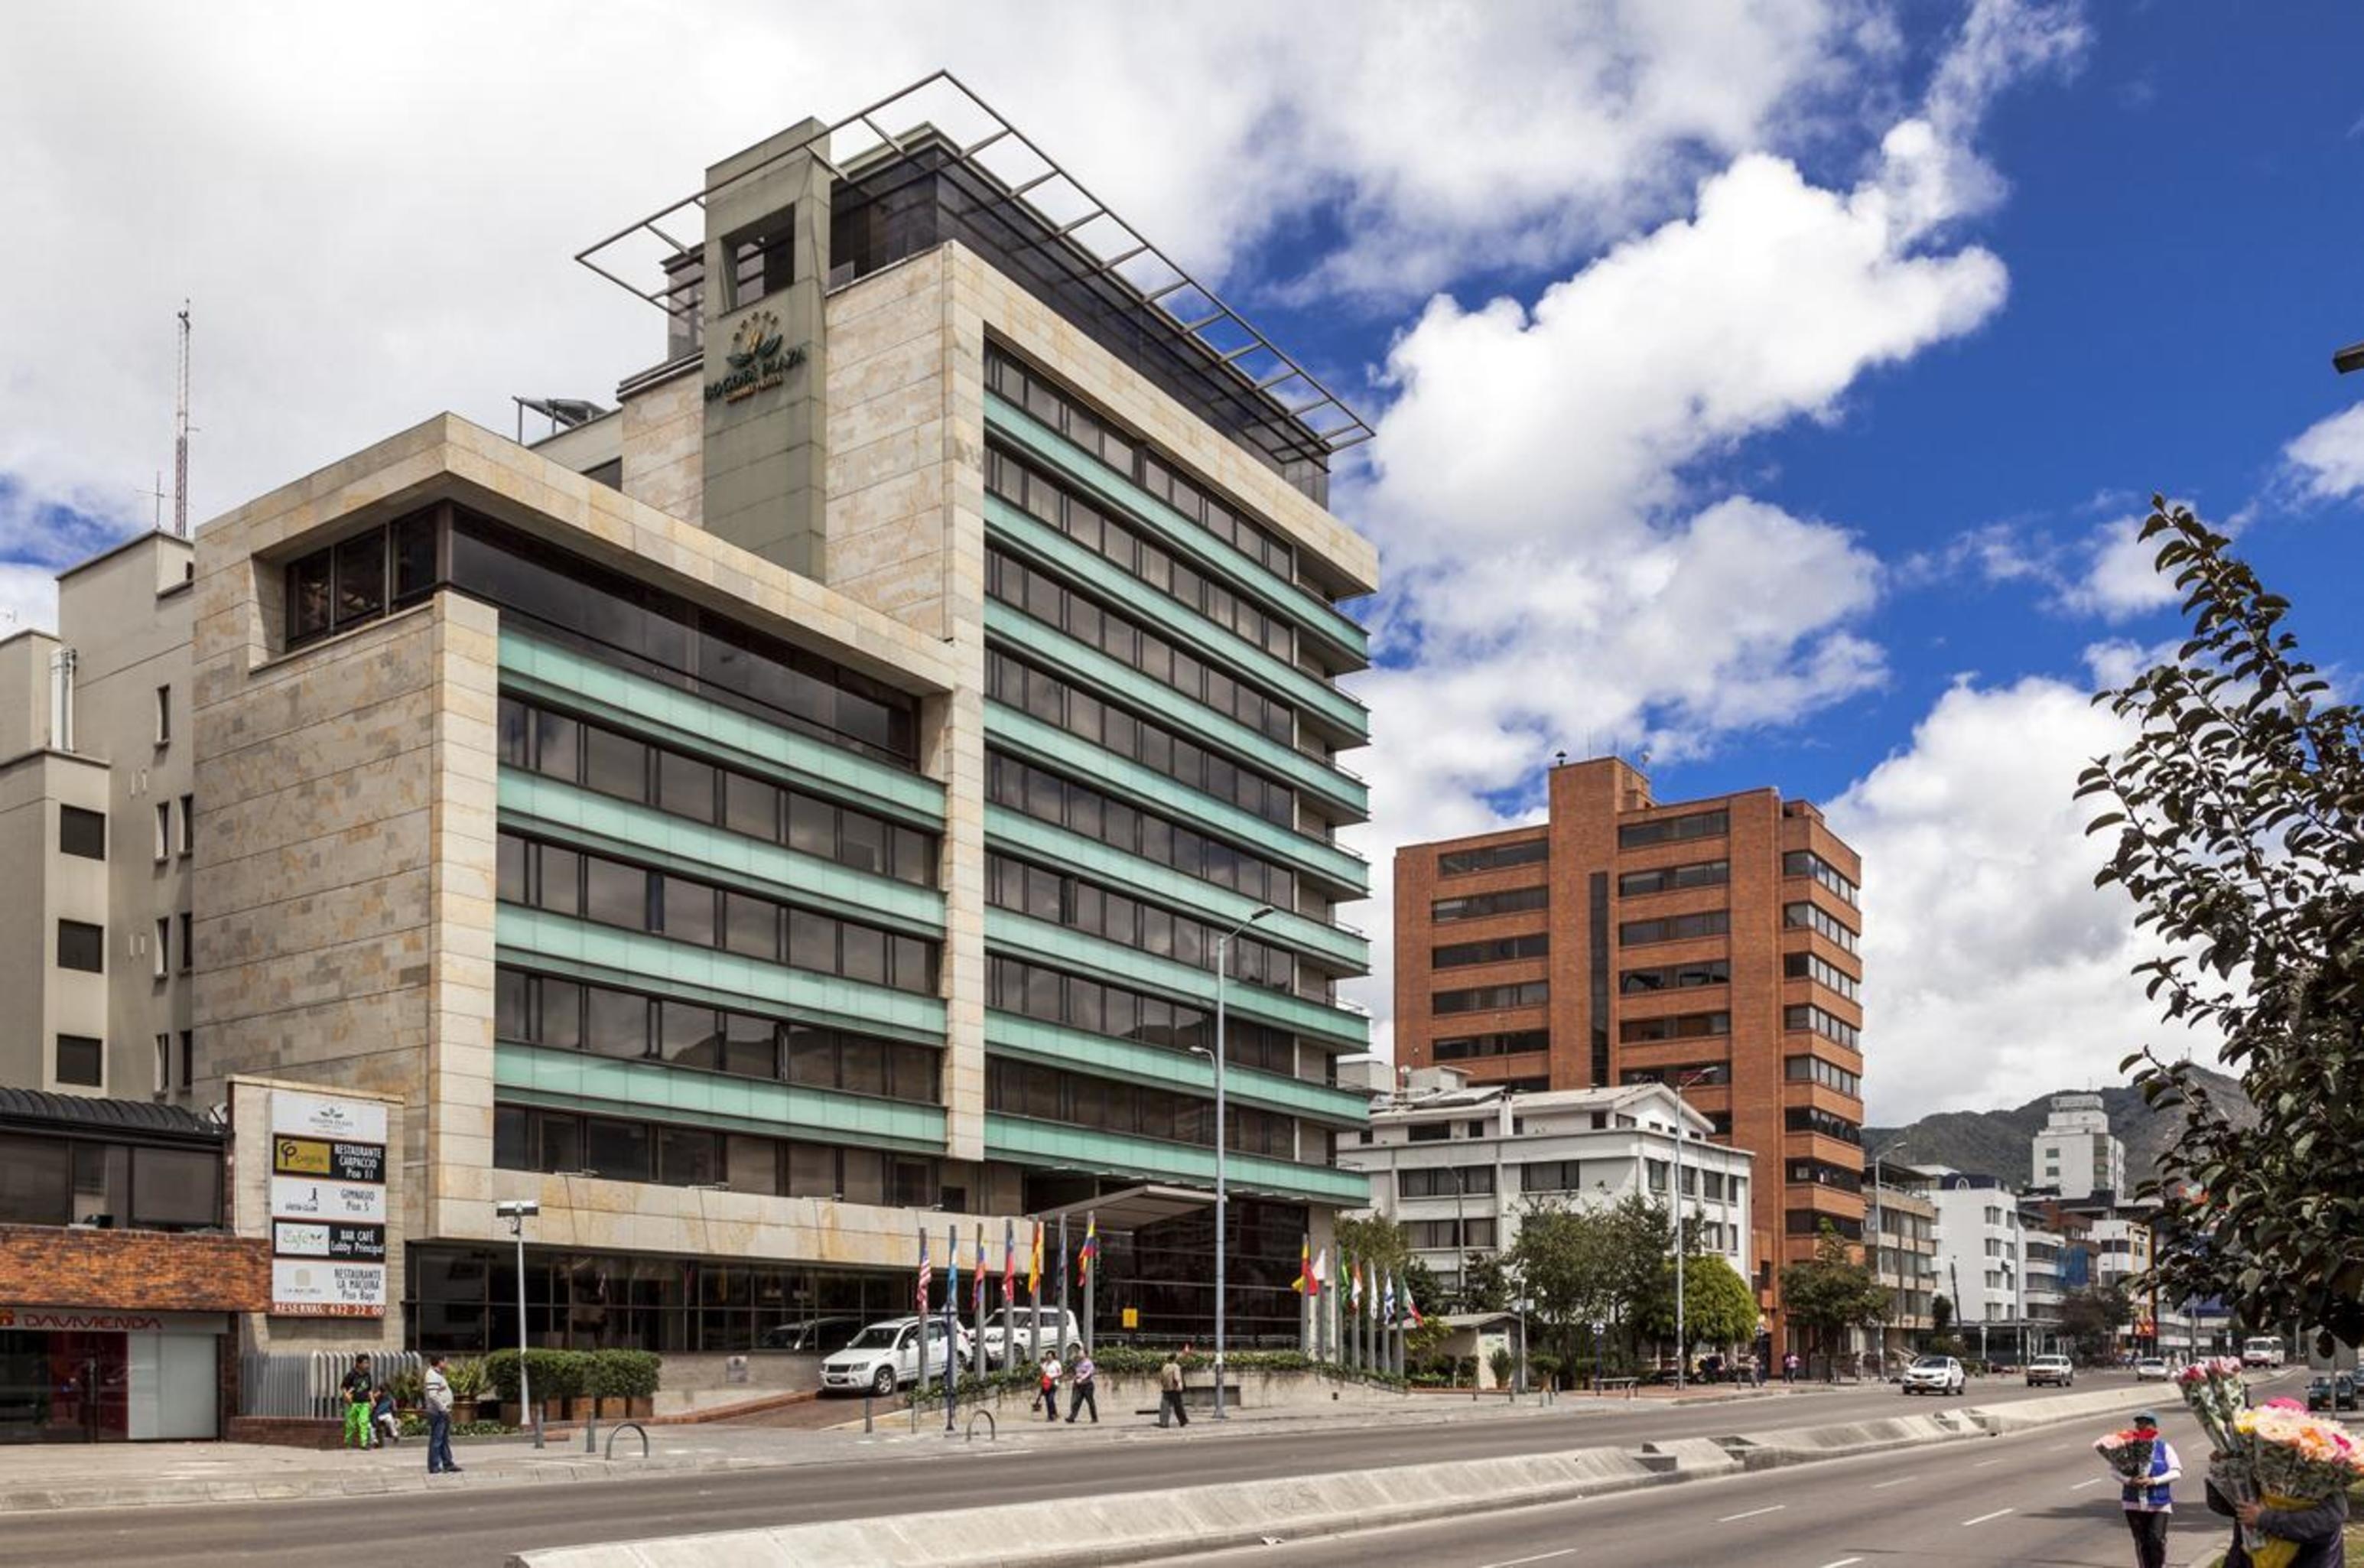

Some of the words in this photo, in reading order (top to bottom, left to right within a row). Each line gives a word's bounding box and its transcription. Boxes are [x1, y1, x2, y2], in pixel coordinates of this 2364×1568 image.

[334, 1143, 382, 1158] RESTAURANTE
[339, 1155, 377, 1169] CARPACCIO
[340, 1229, 355, 1241] BAR
[334, 1268, 381, 1280] RESTAURANTE
[24, 1313, 163, 1330] DAVIVIENDA
